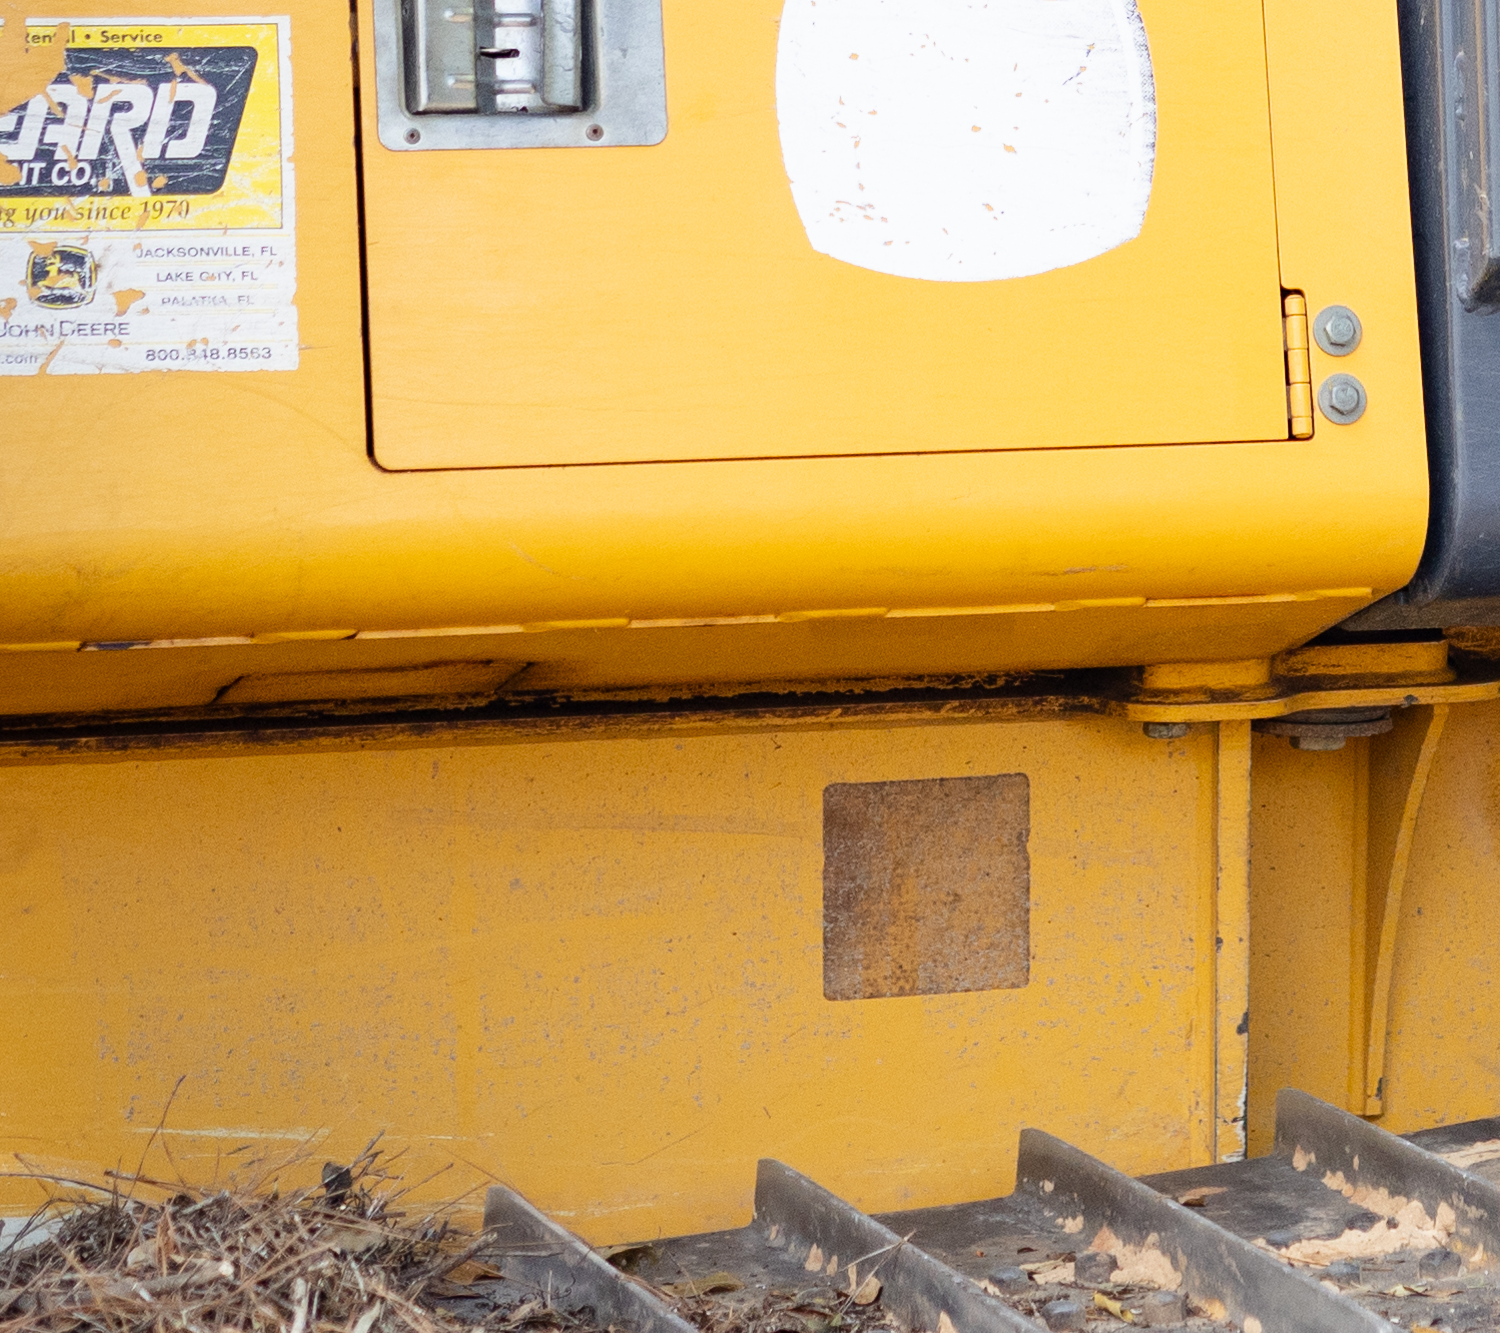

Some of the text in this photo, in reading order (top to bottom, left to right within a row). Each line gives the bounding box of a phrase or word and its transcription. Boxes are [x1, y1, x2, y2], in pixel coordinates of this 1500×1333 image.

[100, 29, 164, 44] Service
[25, 207, 67, 224] you
[77, 201, 131, 221] since
[140, 200, 190, 220] 1970
[136, 244, 278, 259] JACKSONVILLE, FL
[156, 271, 194, 283] LAKE
[241, 270, 258, 282] FL
[237, 295, 254, 306] FL
[59, 319, 130, 337] DEERE
